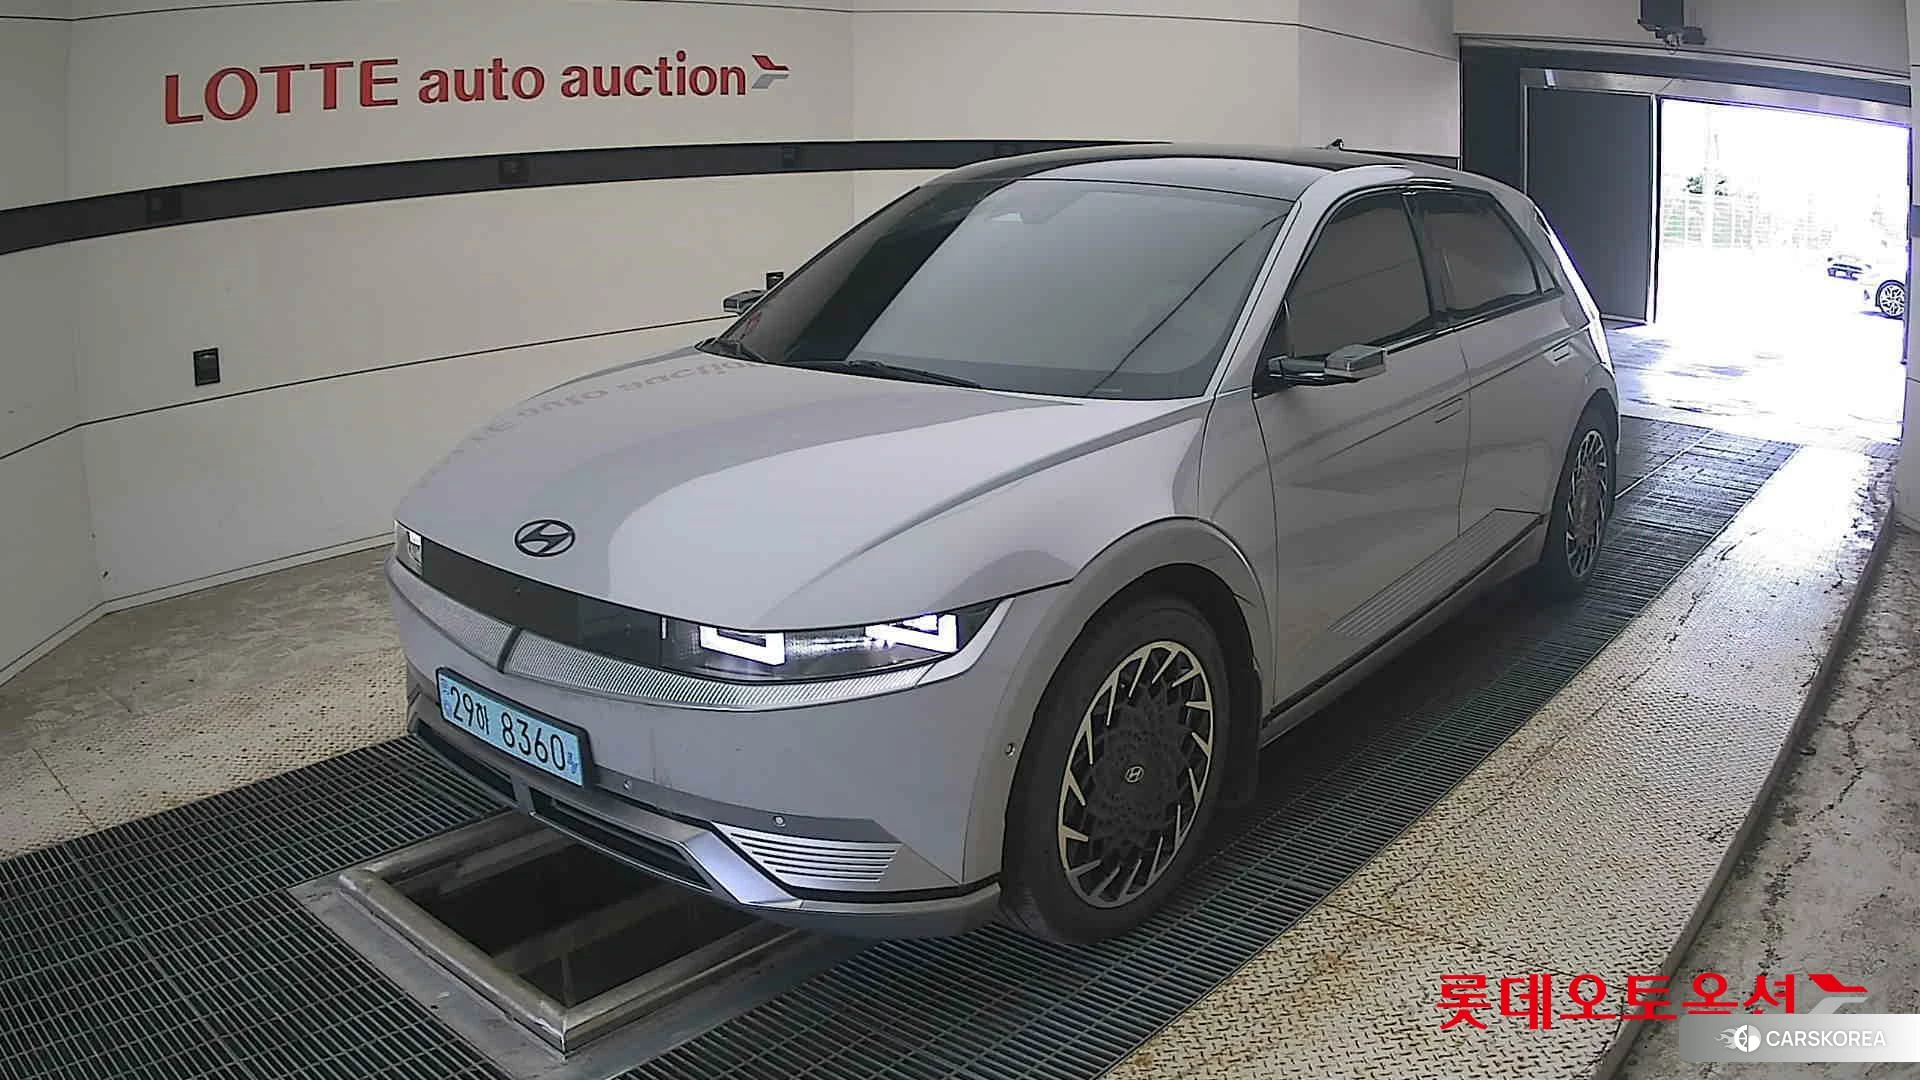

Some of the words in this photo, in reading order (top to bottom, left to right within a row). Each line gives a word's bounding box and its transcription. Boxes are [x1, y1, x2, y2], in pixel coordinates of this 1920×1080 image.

[164, 59, 400, 125] LOTTE
[418, 57, 546, 105] auto
[560, 50, 748, 98] auction
[501, 711, 566, 771] 8360
